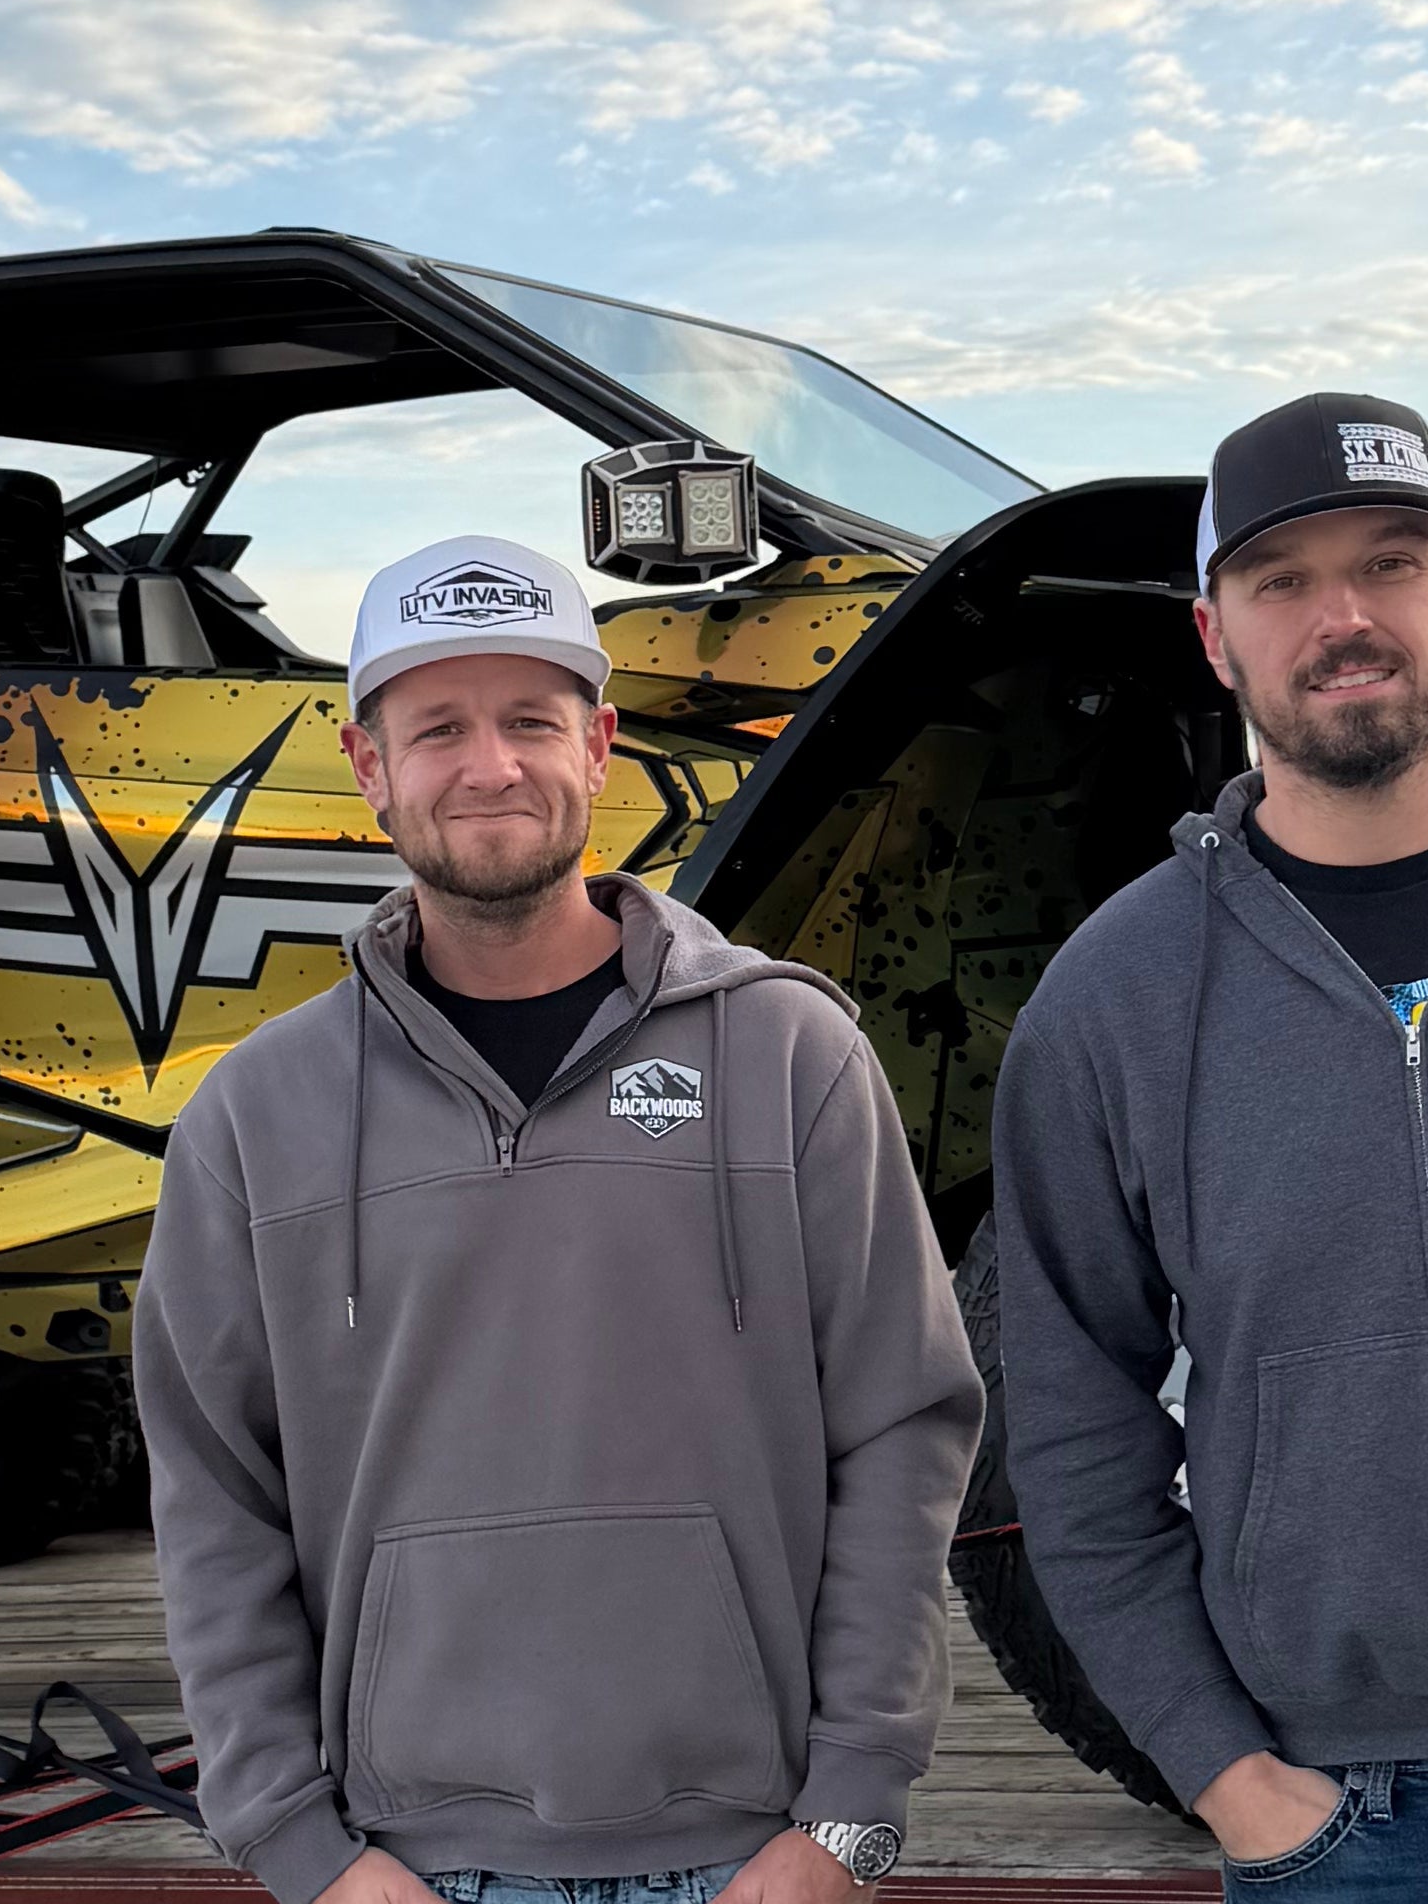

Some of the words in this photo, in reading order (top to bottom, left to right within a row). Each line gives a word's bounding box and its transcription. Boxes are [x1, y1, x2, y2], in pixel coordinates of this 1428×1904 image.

[1341, 439, 1379, 464] SXS
[404, 589, 448, 618] UTV
[453, 586, 549, 612] INVASION
[610, 1097, 703, 1119] BACKWOODS
